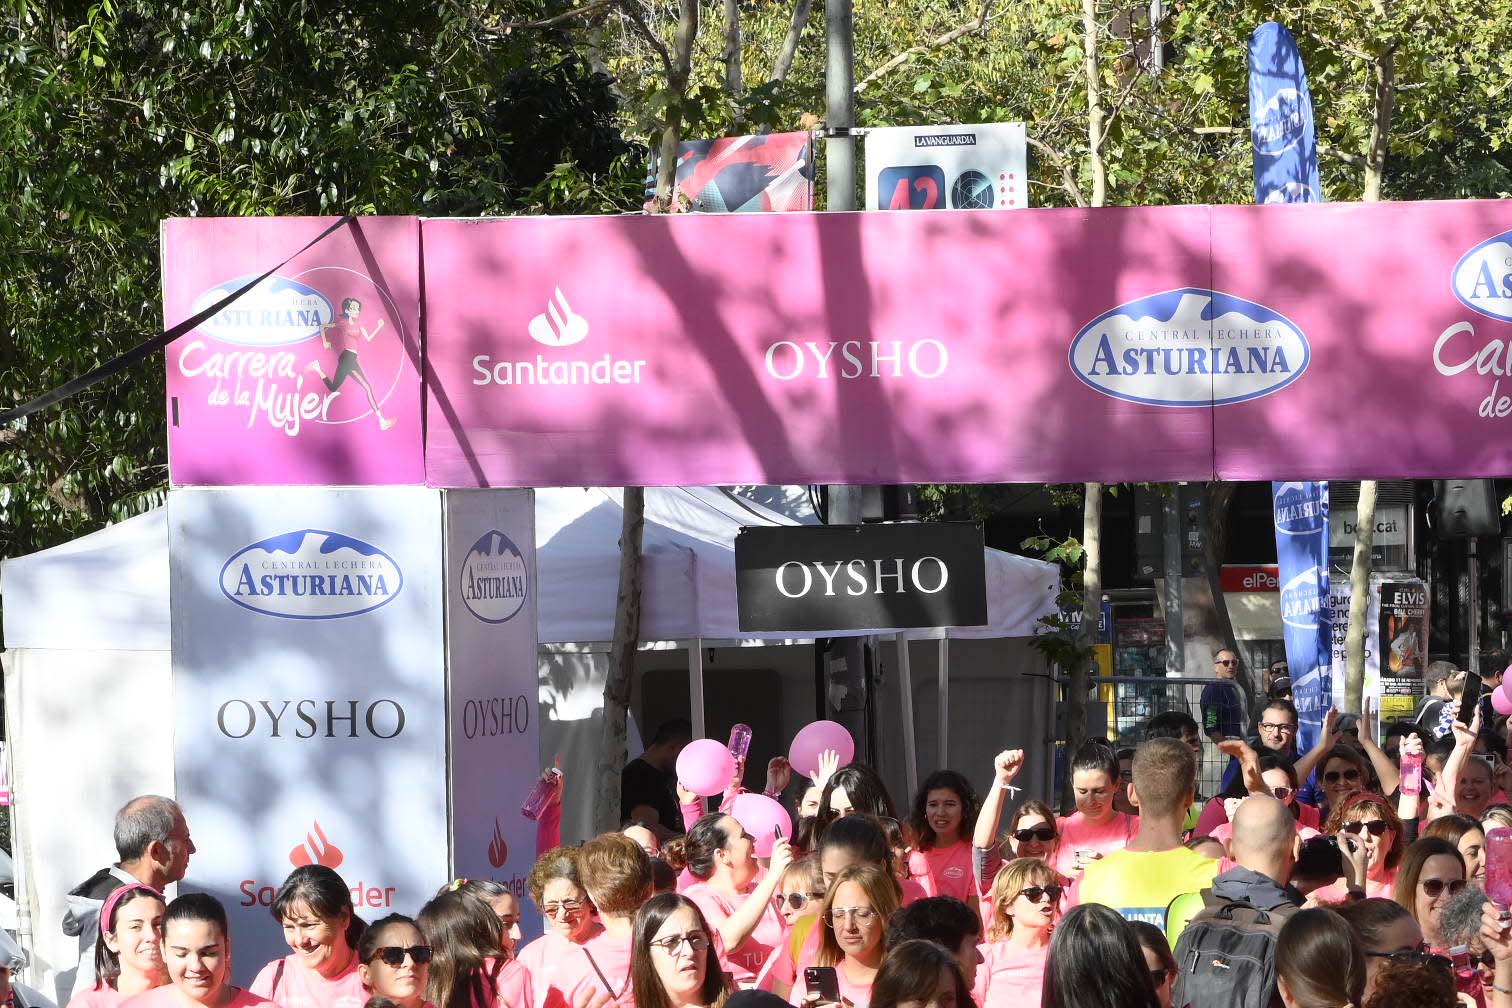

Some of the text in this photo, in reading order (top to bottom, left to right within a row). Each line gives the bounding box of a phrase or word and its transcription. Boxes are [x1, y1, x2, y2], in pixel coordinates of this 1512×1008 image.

[929, 135, 976, 146] VANGUARDIA
[1124, 326, 1284, 341] CENTRAL LECHERA
[179, 340, 297, 378] Carrera
[472, 352, 647, 387] Santander
[764, 338, 949, 381] OYSHO
[1088, 333, 1291, 377] ASTURIANA
[208, 376, 341, 437] de la Mujer
[1479, 384, 1512, 418] de
[235, 562, 389, 598] ASTURIANA
[262, 559, 384, 570] CENTRAL LECHERA
[466, 564, 528, 599] ASTURIANA
[775, 556, 949, 598] OYSHO
[1394, 591, 1425, 605] ELVIS
[216, 698, 406, 740] OYSHO
[463, 694, 529, 740] OYSHO
[744, 951, 764, 967] TU
